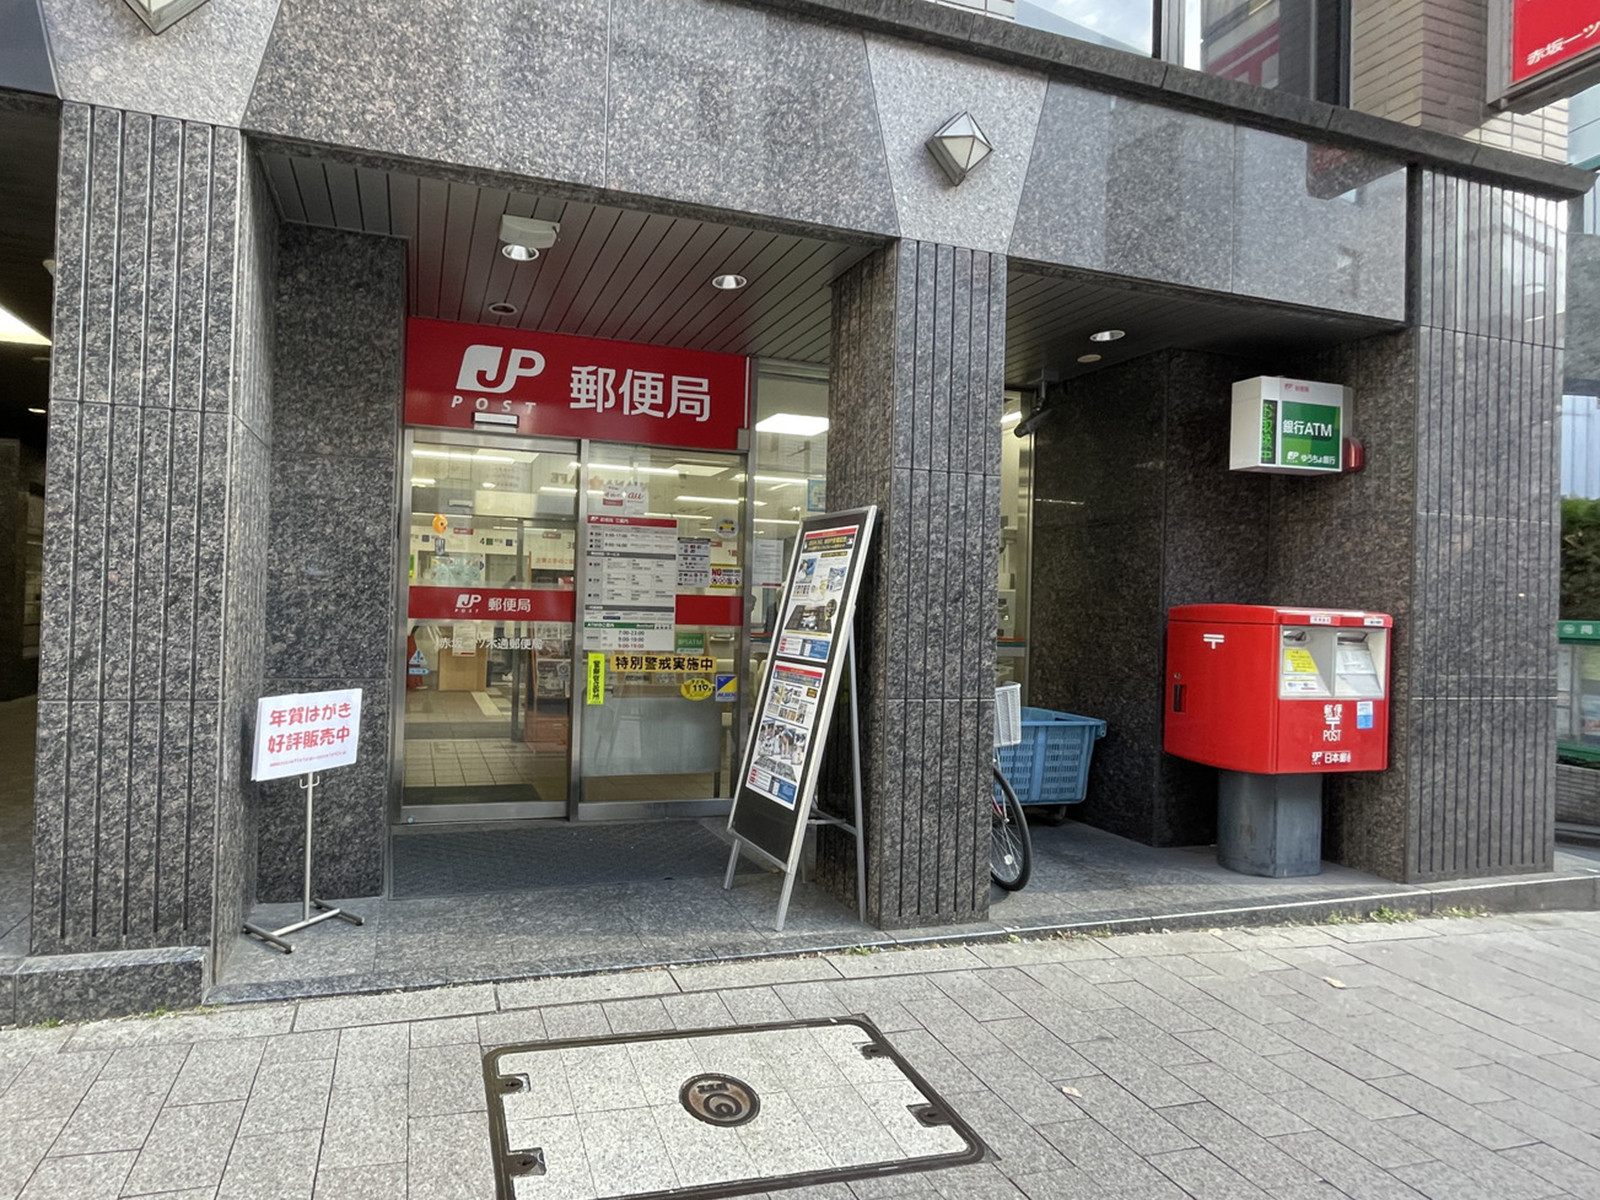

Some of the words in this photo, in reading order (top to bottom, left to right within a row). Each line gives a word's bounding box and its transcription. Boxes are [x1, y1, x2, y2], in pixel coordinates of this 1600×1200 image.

[456, 345, 545, 393] JP
[569, 365, 712, 422] 郵便局
[451, 395, 536, 414] POST
[1283, 419, 1332, 437] 銀行ATM
[1301, 455, 1335, 465] ゆうちょ銀行
[456, 594, 482, 608] JP
[488, 597, 531, 613] 郵便局
[439, 637, 544, 650] 赤坂ツ木通郵便局
[615, 656, 714, 671] 特別警戒実施中
[269, 703, 351, 727] 年賀はがき
[1324, 704, 1342, 718] 郵便
[267, 726, 350, 754] 好評販売中
[1323, 729, 1341, 742] POST
